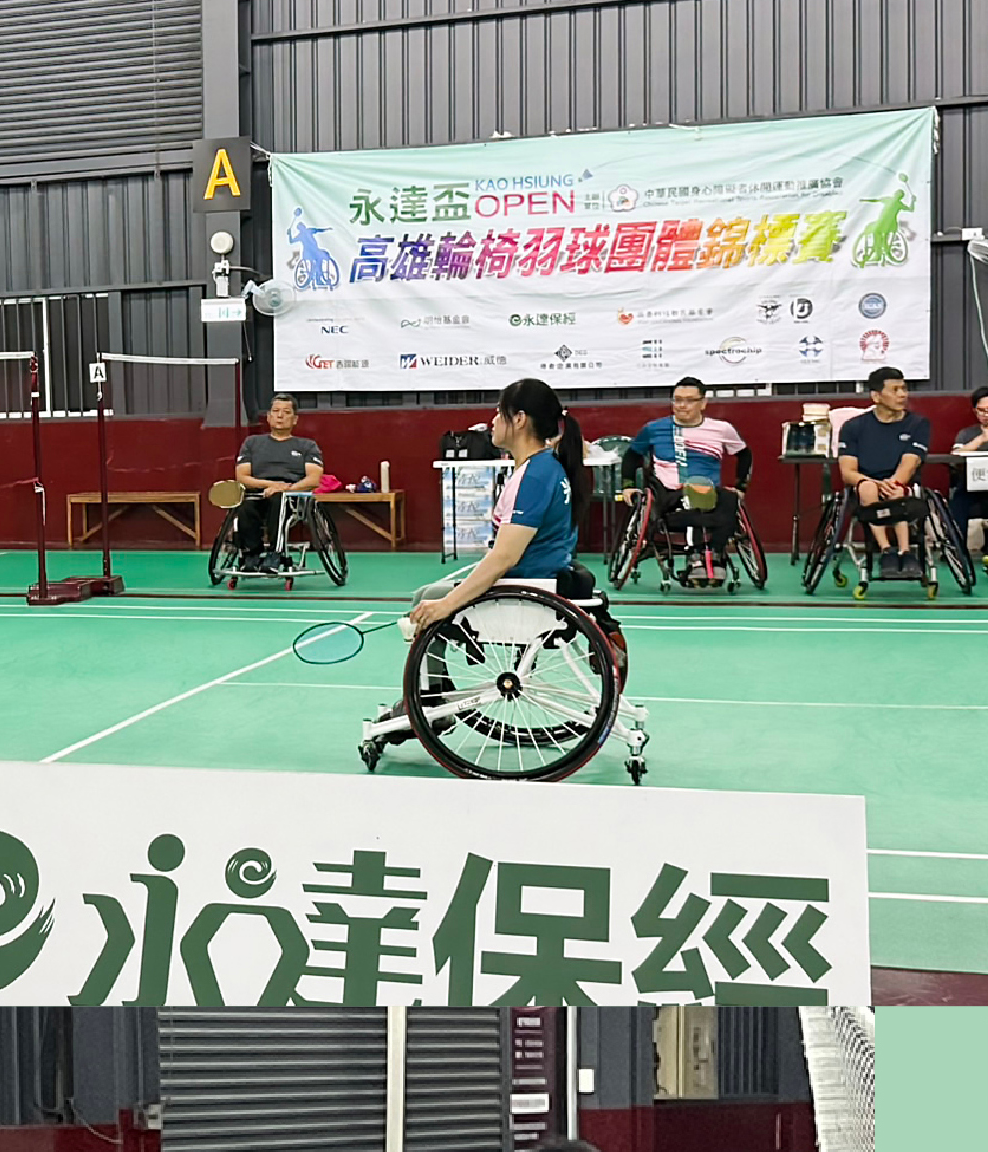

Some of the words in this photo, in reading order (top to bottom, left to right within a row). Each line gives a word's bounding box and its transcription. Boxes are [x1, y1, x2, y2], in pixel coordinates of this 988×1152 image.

[202, 148, 241, 200] A
[475, 178, 508, 191] KAO
[512, 174, 573, 189] HSIUNG
[349, 182, 471, 226] 永達盃
[475, 190, 575, 218] OPEN
[349, 211, 846, 283] 高雄輪椅羽球團體錦標賽
[321, 325, 349, 334] NEC
[523, 312, 576, 326] 永達保經
[92, 365, 105, 380] A
[420, 356, 479, 367] WEIDER
[68, 833, 833, 1006] 永達保經
